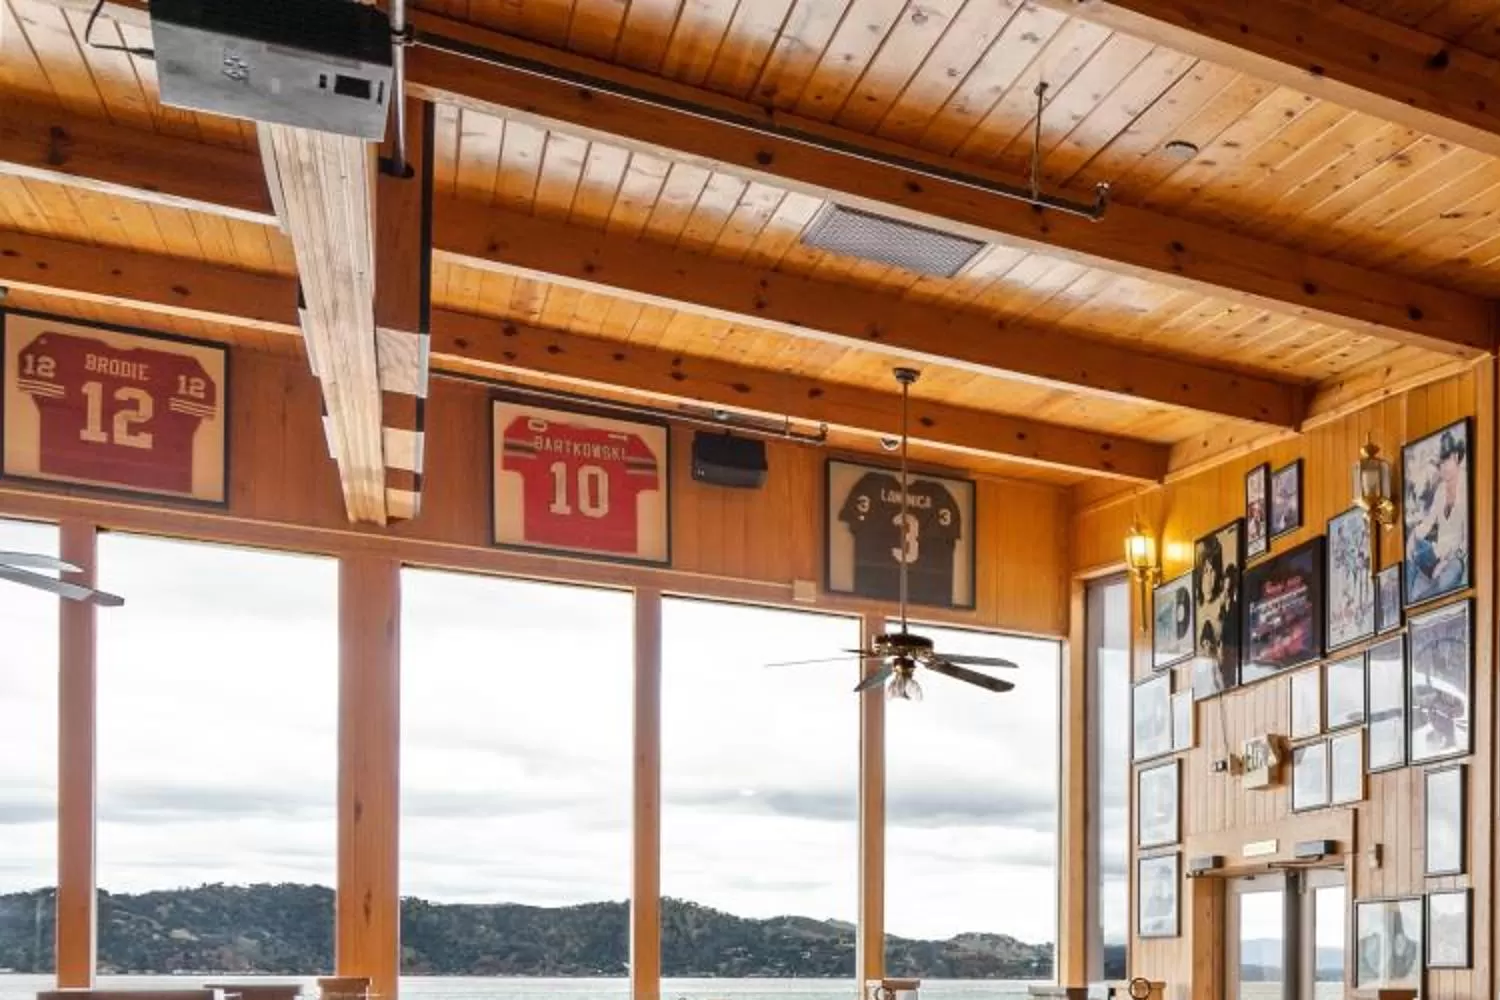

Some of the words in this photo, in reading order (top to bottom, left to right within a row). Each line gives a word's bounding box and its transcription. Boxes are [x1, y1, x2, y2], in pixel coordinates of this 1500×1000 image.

[23, 353, 56, 378] 12
[84, 353, 149, 381] BRODIE
[177, 375, 206, 399] 12
[79, 380, 153, 449] 12
[549, 461, 609, 518] 10
[856, 495, 870, 513] 3
[938, 508, 951, 526] 3
[891, 513, 920, 564] 3
